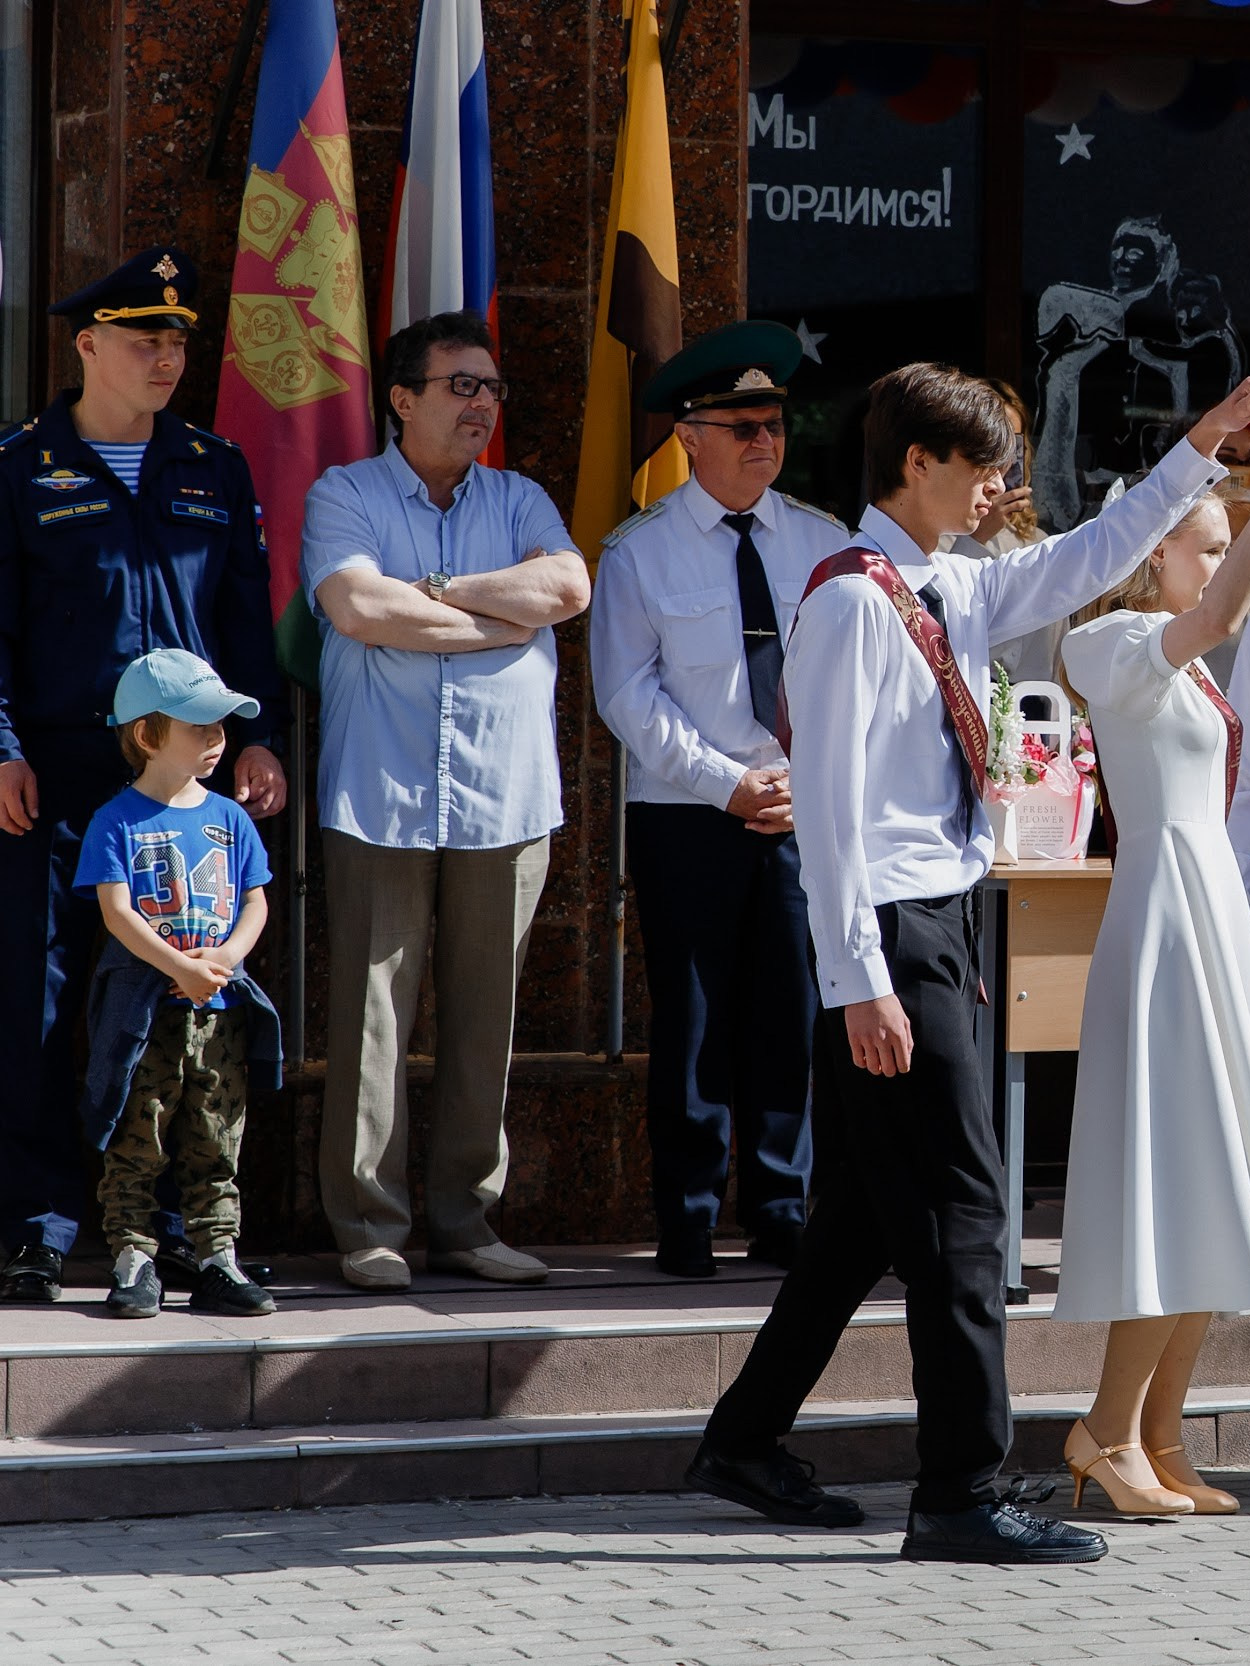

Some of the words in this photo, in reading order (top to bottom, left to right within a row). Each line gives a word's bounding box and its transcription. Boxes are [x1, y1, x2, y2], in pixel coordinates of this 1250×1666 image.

[747, 92, 816, 150] Мы
[1019, 815, 1065, 824] FLOWER
[1023, 805, 1057, 814] FRESH
[131, 843, 236, 924] 34
